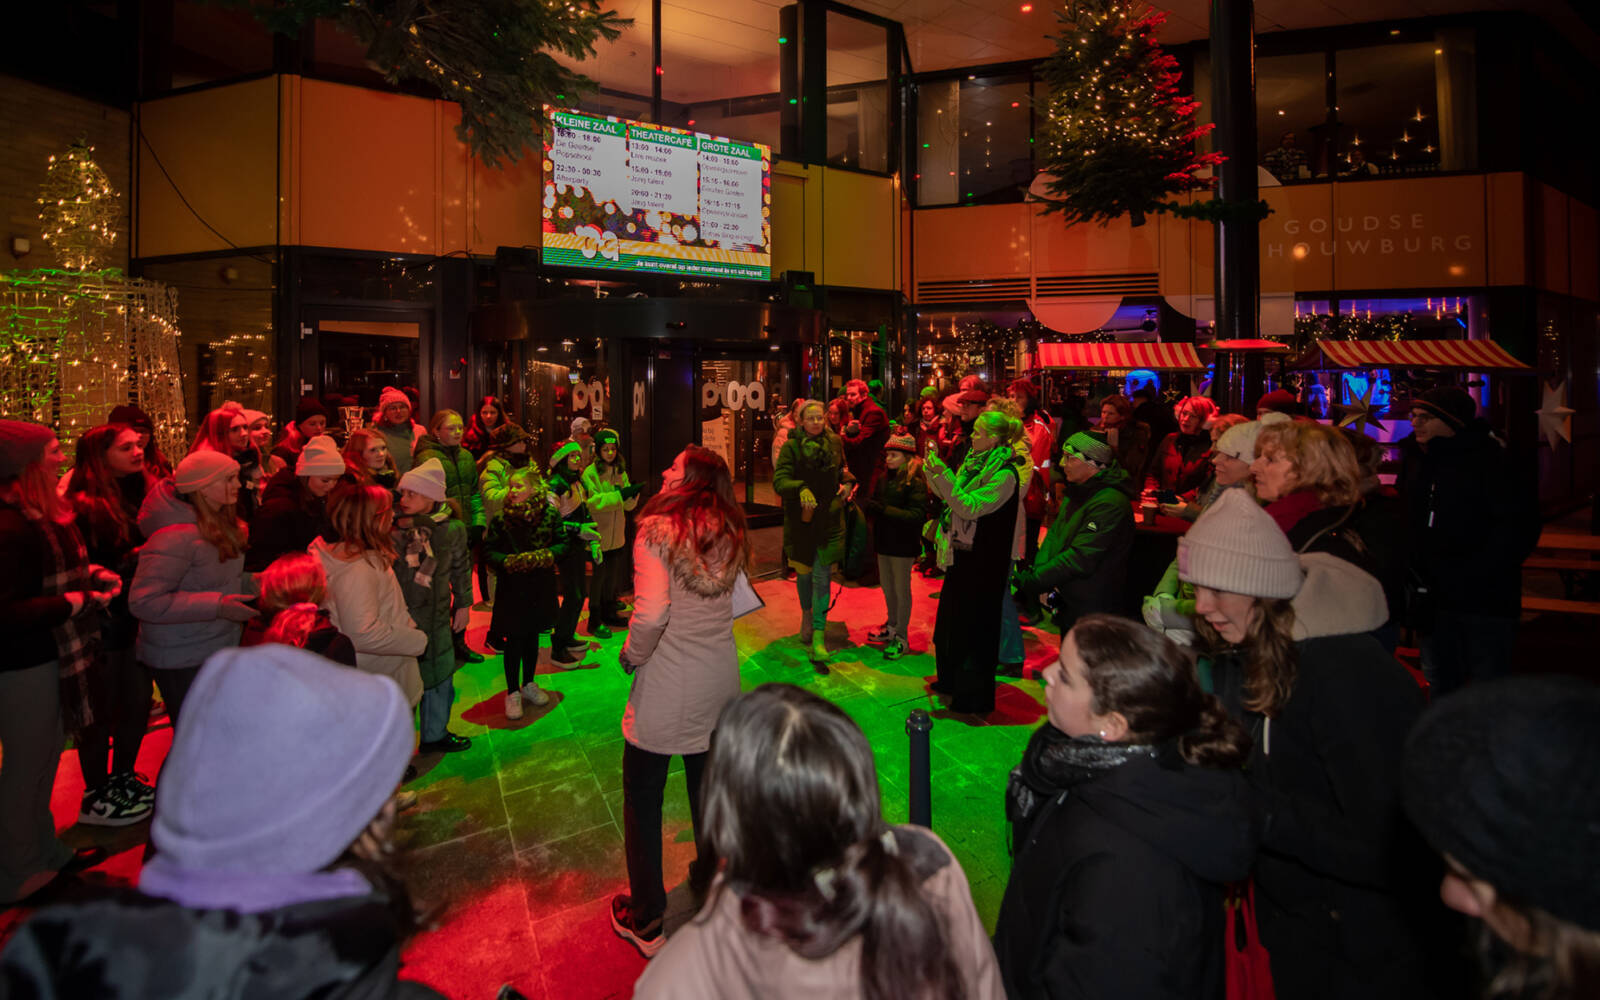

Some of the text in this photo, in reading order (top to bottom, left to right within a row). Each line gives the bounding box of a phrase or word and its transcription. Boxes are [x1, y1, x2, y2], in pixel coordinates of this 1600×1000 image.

[556, 115, 617, 134] KLEINE ZAAL
[701, 141, 751, 158] GROTE ZAAL
[1283, 213, 1425, 235] GOUDSE
[1267, 234, 1473, 258] HOUWBURG
